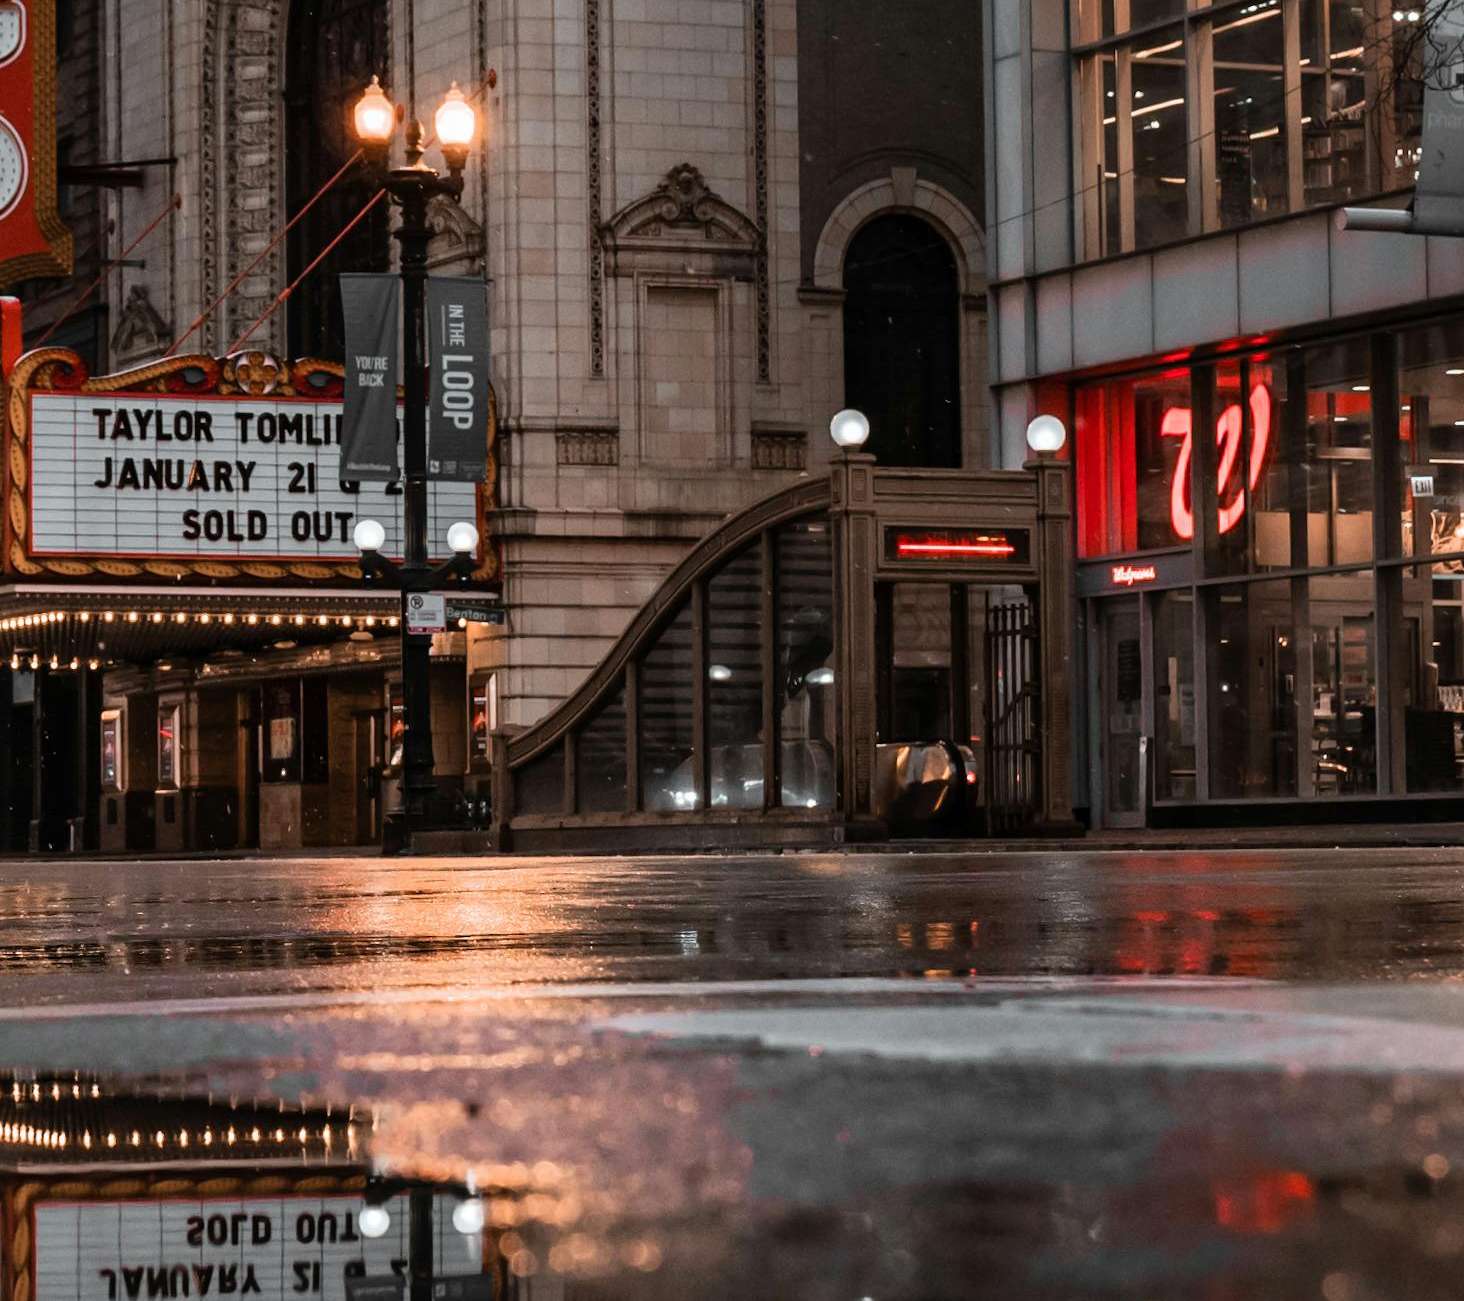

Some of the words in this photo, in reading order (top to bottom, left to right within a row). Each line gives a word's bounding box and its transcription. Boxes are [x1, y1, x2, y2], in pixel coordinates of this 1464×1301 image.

[448, 304, 464, 318] IN
[449, 321, 466, 347] THE
[355, 354, 389, 371] YOU'RE
[358, 373, 385, 387] BACK
[442, 355, 475, 431] LOOP
[92, 408, 214, 443] TAYLOR
[94, 456, 256, 493] JANUARY
[288, 462, 316, 494] 21
[1160, 382, 1271, 539] W
[182, 509, 267, 542] SOLD
[292, 510, 353, 543] OUT
[446, 606, 487, 621] Benton
